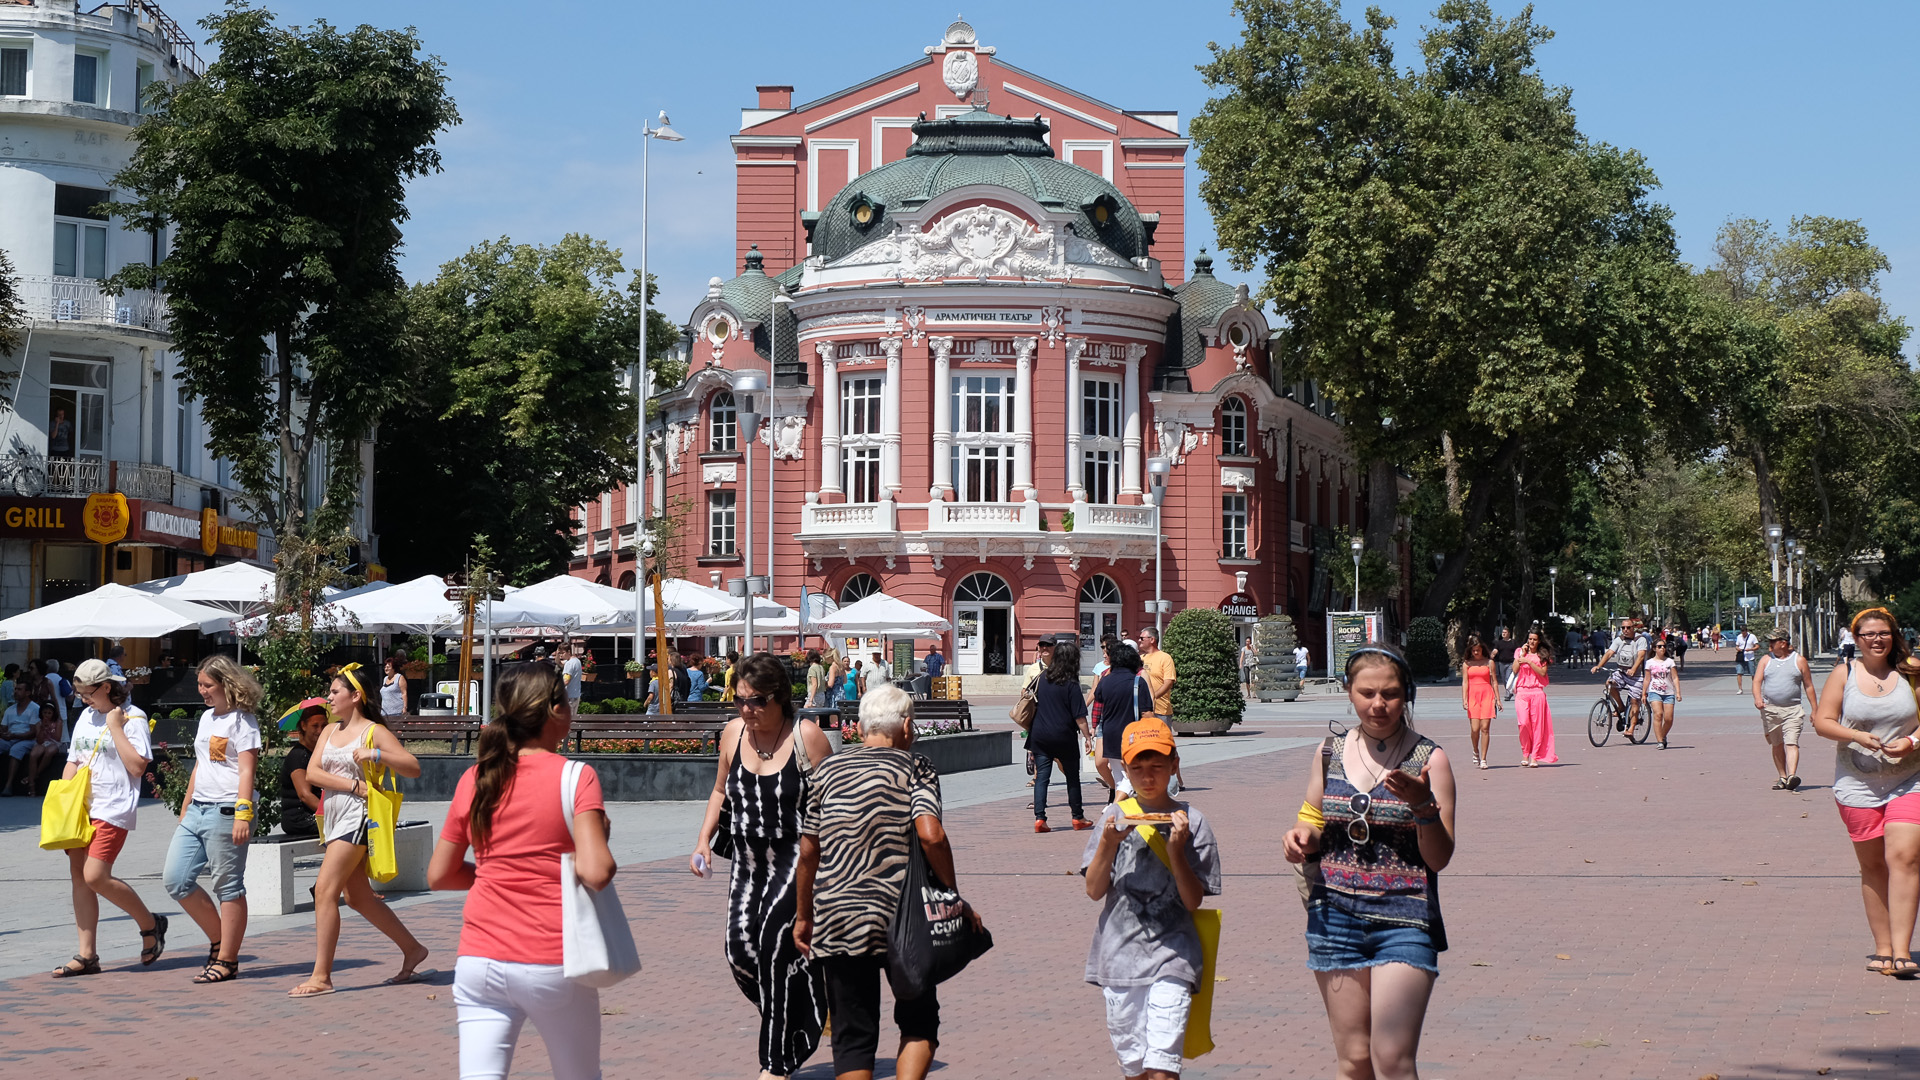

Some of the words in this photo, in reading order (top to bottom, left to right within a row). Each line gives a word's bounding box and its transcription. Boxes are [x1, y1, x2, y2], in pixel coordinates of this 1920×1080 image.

[934, 312, 996, 321] ДРАМАТИЧЕН
[999, 312, 1033, 321] ТЕАТЪР
[5, 507, 65, 528] GRILL
[146, 511, 180, 536] МОРСКО
[220, 526, 237, 546] PIZZA
[238, 530, 243, 547] &
[243, 530, 258, 549] GRILL
[1222, 605, 1257, 615] CHANGE
